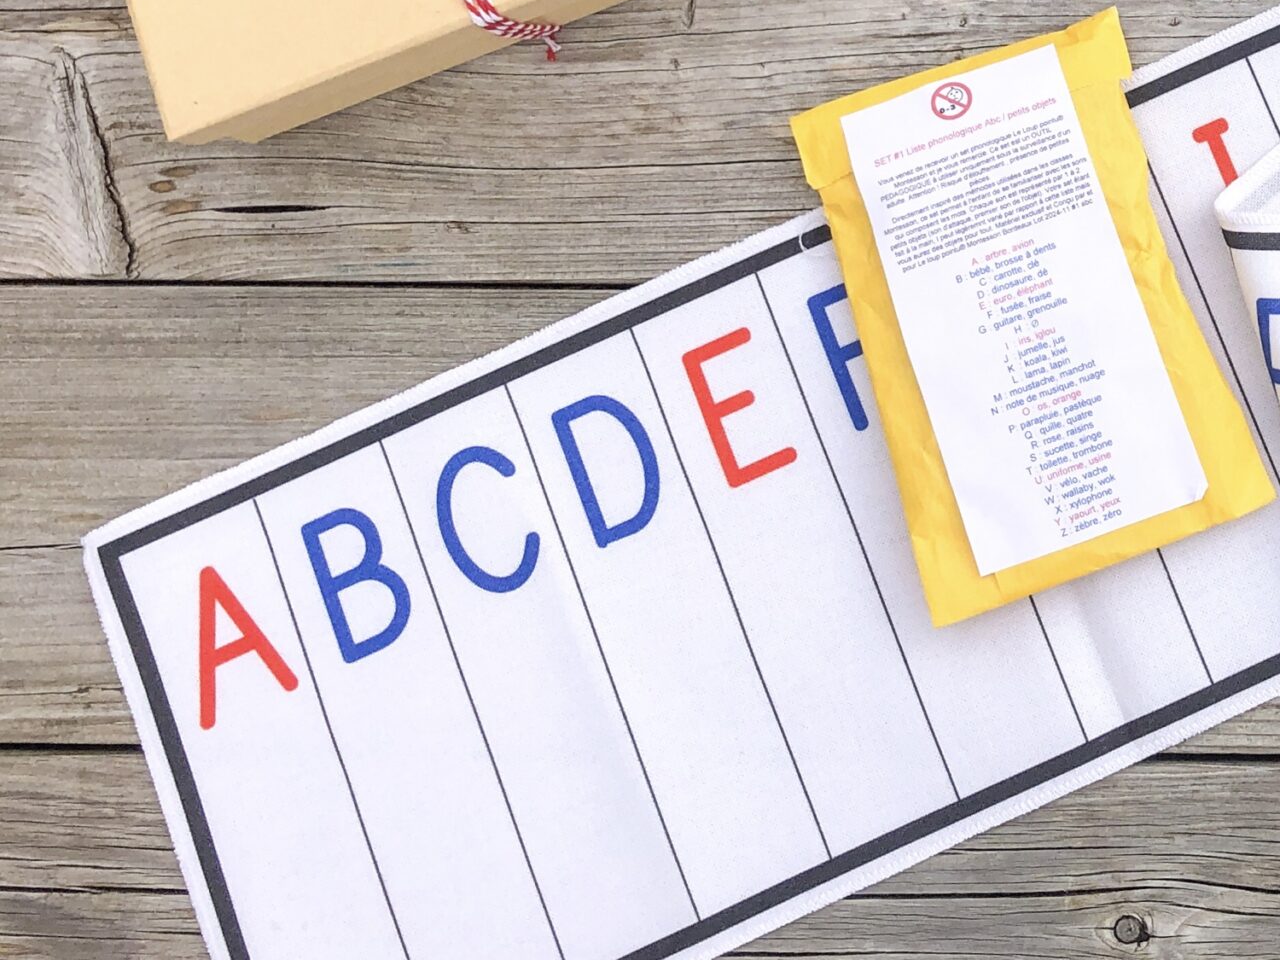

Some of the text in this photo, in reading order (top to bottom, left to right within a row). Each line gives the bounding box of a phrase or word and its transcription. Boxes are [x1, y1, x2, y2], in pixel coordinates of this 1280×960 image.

[874, 154, 891, 168] SET
[894, 151, 904, 160] #1
[906, 144, 926, 156] Liste
[927, 123, 982, 149] phonologique
[985, 117, 1001, 127] Abc
[1007, 106, 1030, 120] petits
[1032, 98, 1056, 111] objets
[1031, 128, 1052, 139] OUTIL
[878, 176, 894, 186] Vous
[950, 152, 959, 160] un
[970, 133, 1012, 153] phonologique
[1045, 167, 1060, 176] avec
[1033, 216, 1044, 224] Lot
[955, 242, 1056, 284] B bébé, brosse à dents
[971, 257, 979, 266] A
[1012, 239, 1035, 252] avion
[976, 268, 1048, 300] D dinosaure, dé
[979, 259, 1040, 286] C carotte, clé
[978, 301, 987, 310] E
[1016, 278, 1053, 297] éléphant
[987, 310, 993, 319] F
[1028, 291, 1052, 304] fraise
[978, 298, 1067, 334] G guitare, grenouille
[1014, 325, 1022, 334] H
[1035, 327, 1056, 340] iglou
[1004, 336, 1065, 363] J jumelle, jus
[1007, 364, 1015, 373] K
[1051, 346, 1068, 357] kiwi
[993, 393, 1003, 402] M
[1059, 359, 1096, 378] manchot
[1011, 376, 1018, 384] L
[1049, 358, 1071, 370] lapin
[991, 369, 1105, 416] N note de musique, nuage
[1022, 390, 1082, 416] O os, orange
[1020, 411, 1062, 431] parapluie,
[1063, 395, 1102, 416] pastèque
[1024, 410, 1093, 440] Q quille, quatre
[1029, 431, 1102, 462] S sucette, singe
[1030, 440, 1039, 450] R
[1066, 422, 1094, 437] raisins
[1025, 439, 1113, 475] T toilette, trombone
[1047, 462, 1087, 481] uniforme,
[1088, 452, 1112, 465] usine
[1044, 474, 1116, 505] W wallaby, wok
[1045, 465, 1108, 493] V vélo, vache
[1054, 517, 1061, 526] Y
[1100, 497, 1121, 512] yeux
[1055, 488, 1112, 515] X xylophone
[200, 566, 299, 730] A
[301, 507, 411, 663] B
[436, 446, 540, 593] C
[551, 395, 659, 548] D
[682, 327, 797, 488] E
[1060, 528, 1068, 537] Z
[1103, 509, 1122, 521] zéro
